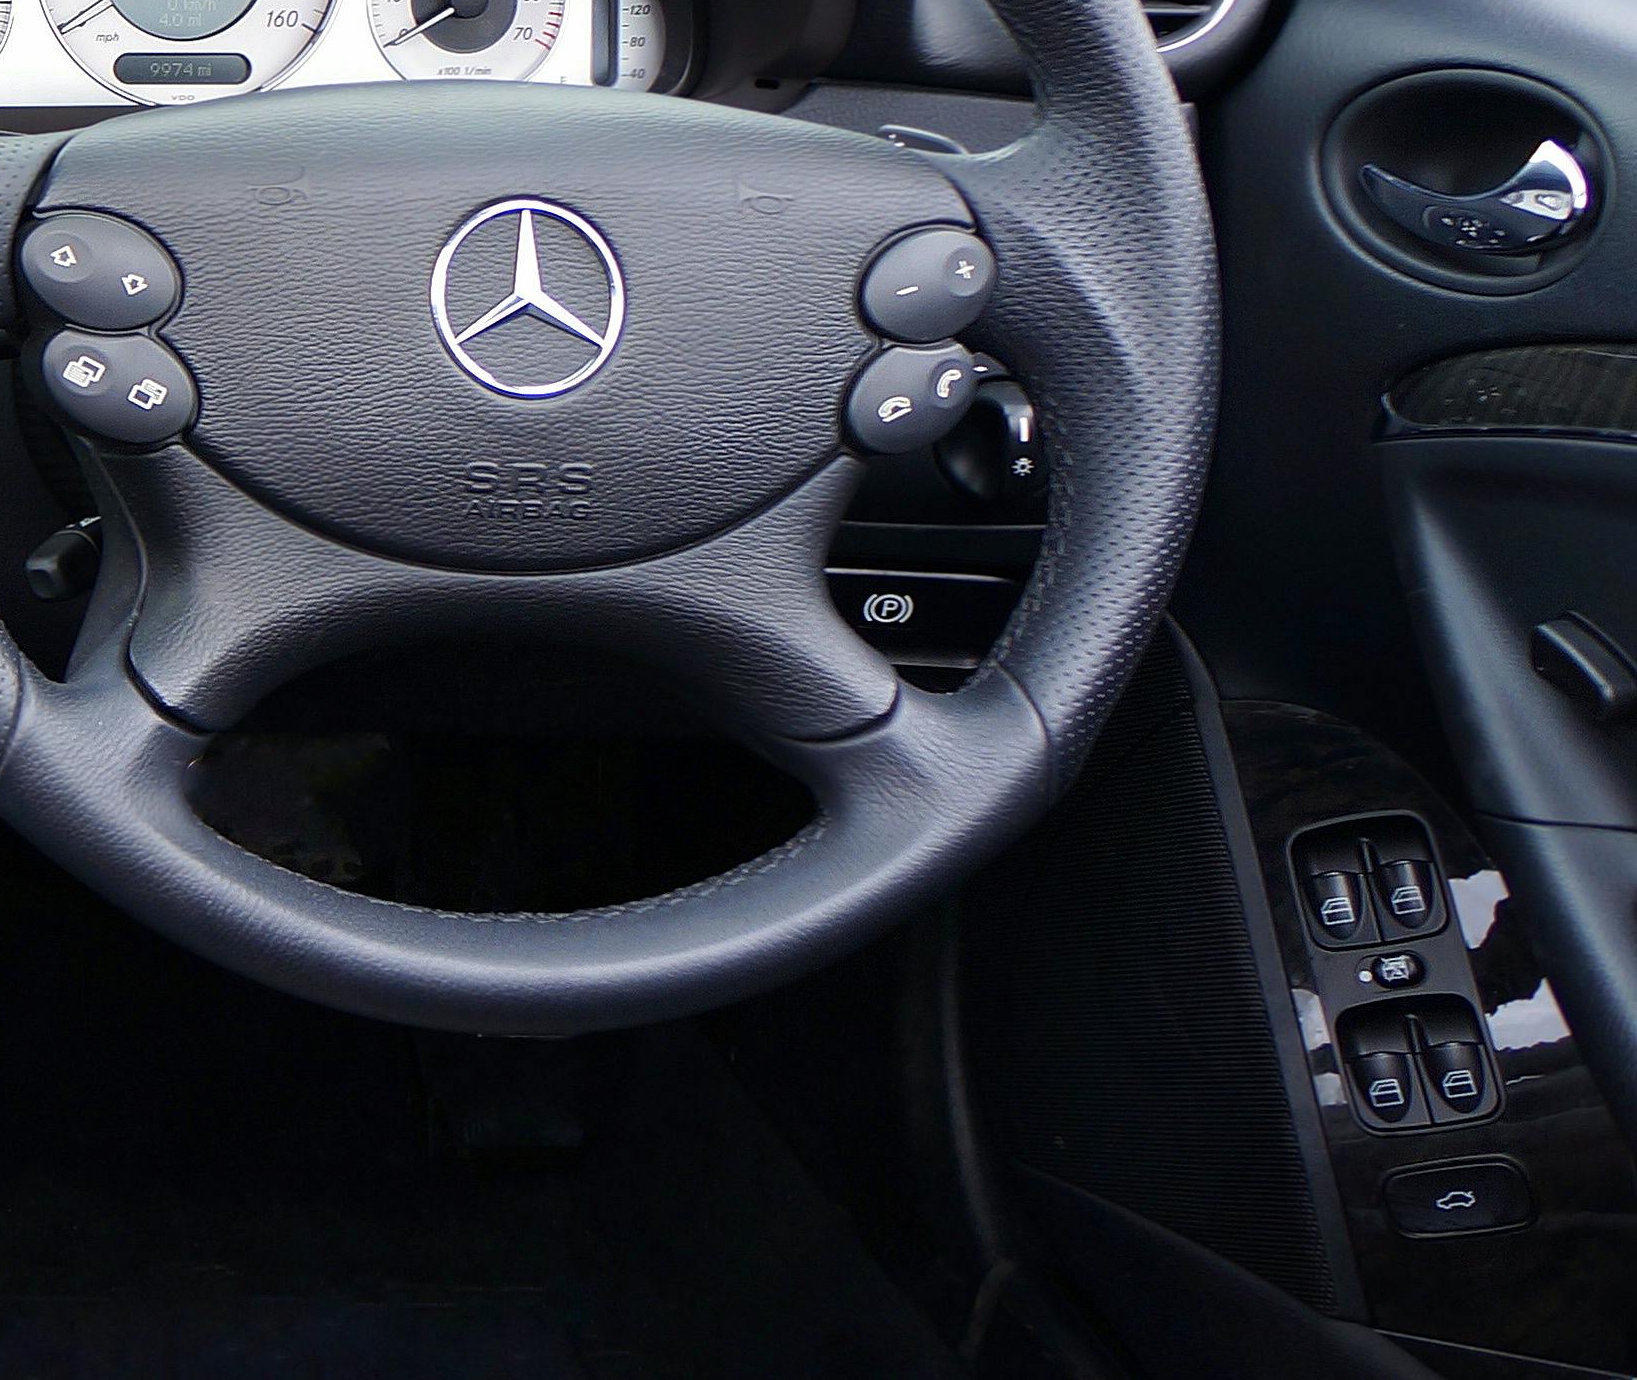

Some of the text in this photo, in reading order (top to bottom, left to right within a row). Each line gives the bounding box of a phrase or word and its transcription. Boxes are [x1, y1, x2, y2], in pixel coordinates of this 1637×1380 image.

[630, 4, 651, 16] 120
[266, 10, 299, 28] 160
[96, 33, 120, 42] mph
[513, 27, 533, 41] 70
[629, 37, 646, 47] 80
[150, 62, 194, 77] 9974
[629, 68, 646, 79] 40
[468, 461, 594, 495] SRS
[465, 498, 593, 520] AIRBAG
